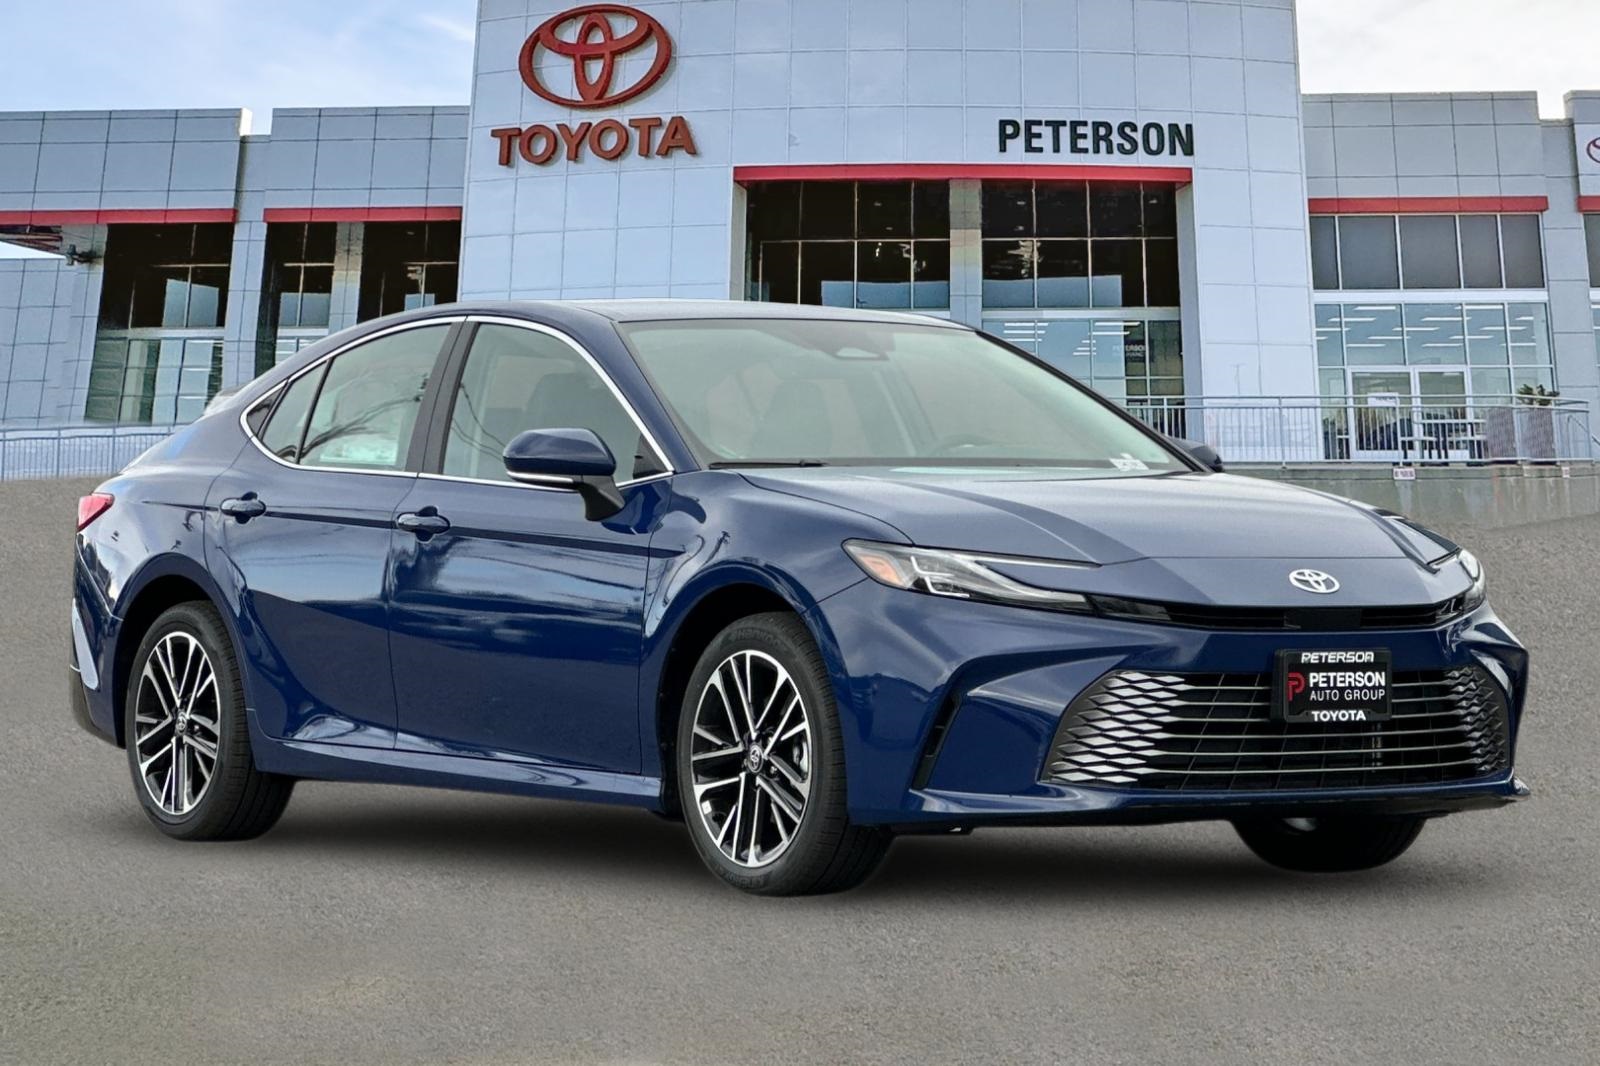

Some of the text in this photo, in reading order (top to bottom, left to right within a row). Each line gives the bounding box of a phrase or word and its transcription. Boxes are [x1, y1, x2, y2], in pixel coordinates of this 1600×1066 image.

[491, 116, 697, 166] TOYOTA
[998, 119, 1195, 156] PETERSON
[1309, 672, 1386, 687] PETERSON
[1310, 689, 1386, 701] AUTO GROUP
[1312, 710, 1366, 722] TOYOTA
